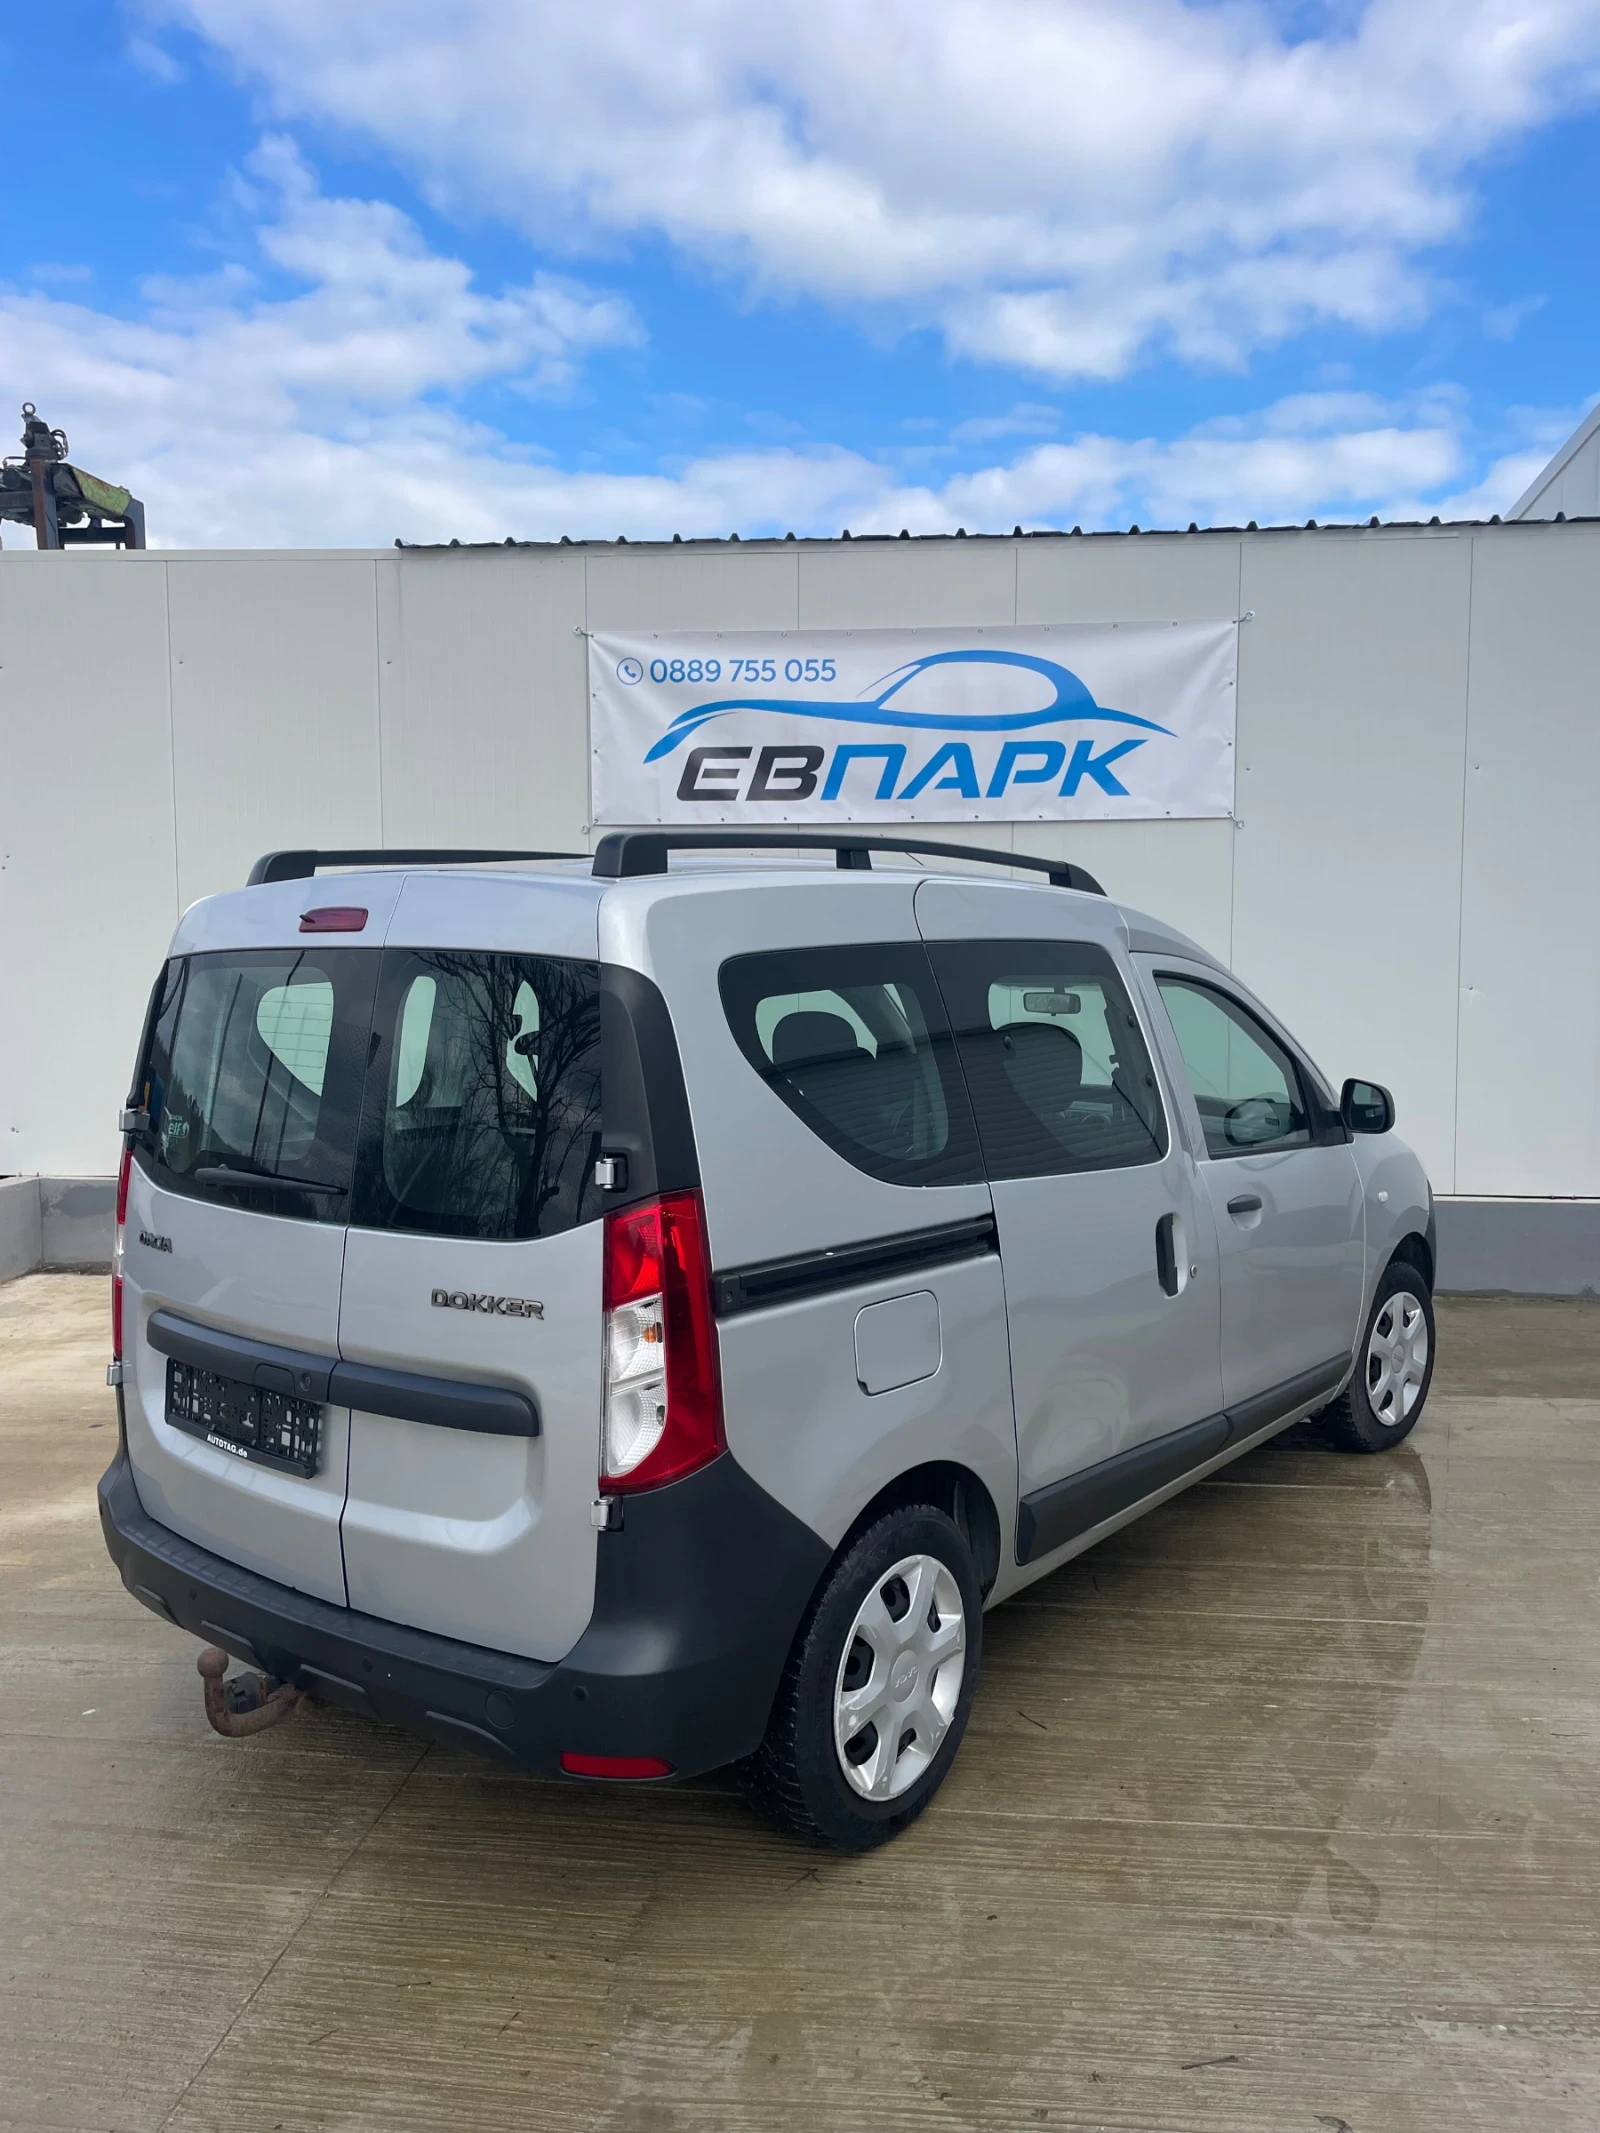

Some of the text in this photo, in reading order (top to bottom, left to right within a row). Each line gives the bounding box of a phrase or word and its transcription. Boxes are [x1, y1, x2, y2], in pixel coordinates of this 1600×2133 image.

[650, 658, 837, 684] 0889 755 055
[676, 738, 1149, 802] ЕВПАРК
[167, 1121, 182, 1136] elf
[430, 1288, 545, 1321] DOKKER
[206, 1433, 248, 1458] AUTOTAG.de
